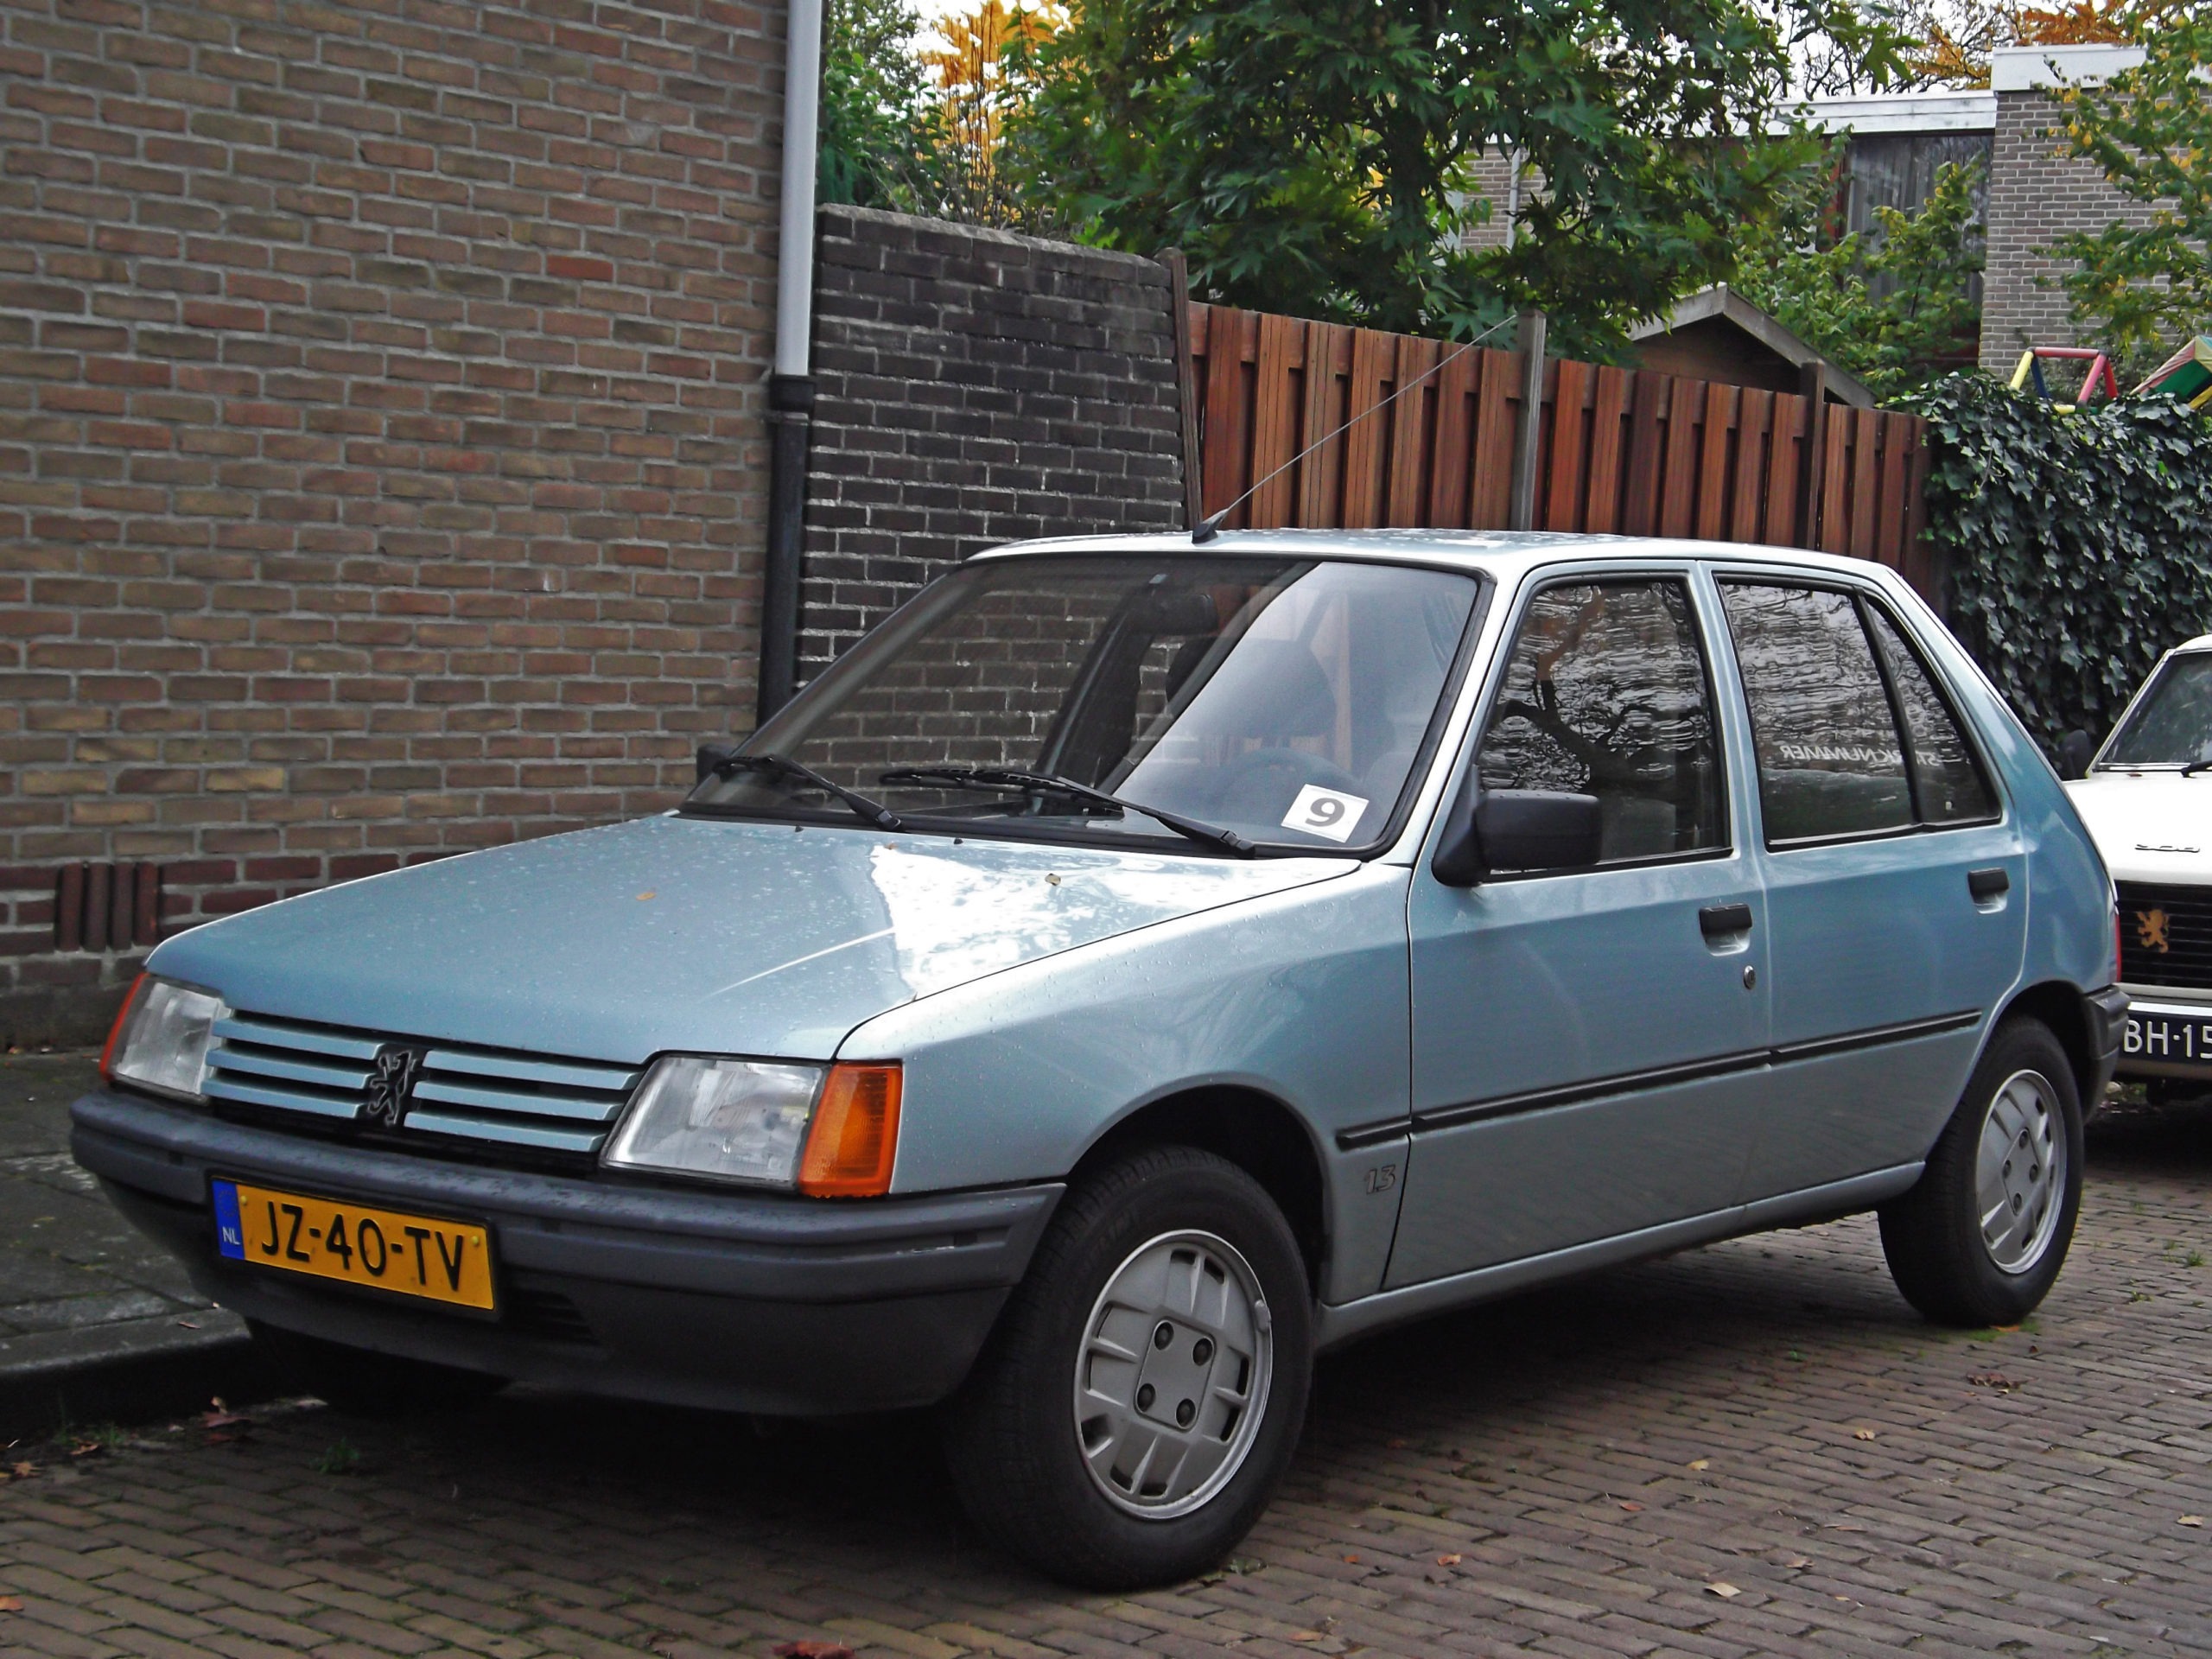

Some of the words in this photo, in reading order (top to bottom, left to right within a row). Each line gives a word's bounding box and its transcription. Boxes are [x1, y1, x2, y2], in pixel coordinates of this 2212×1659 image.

[1305, 797, 1345, 827] 9
[222, 1226, 240, 1245] NL
[262, 1201, 463, 1292] JZ-40-TV
